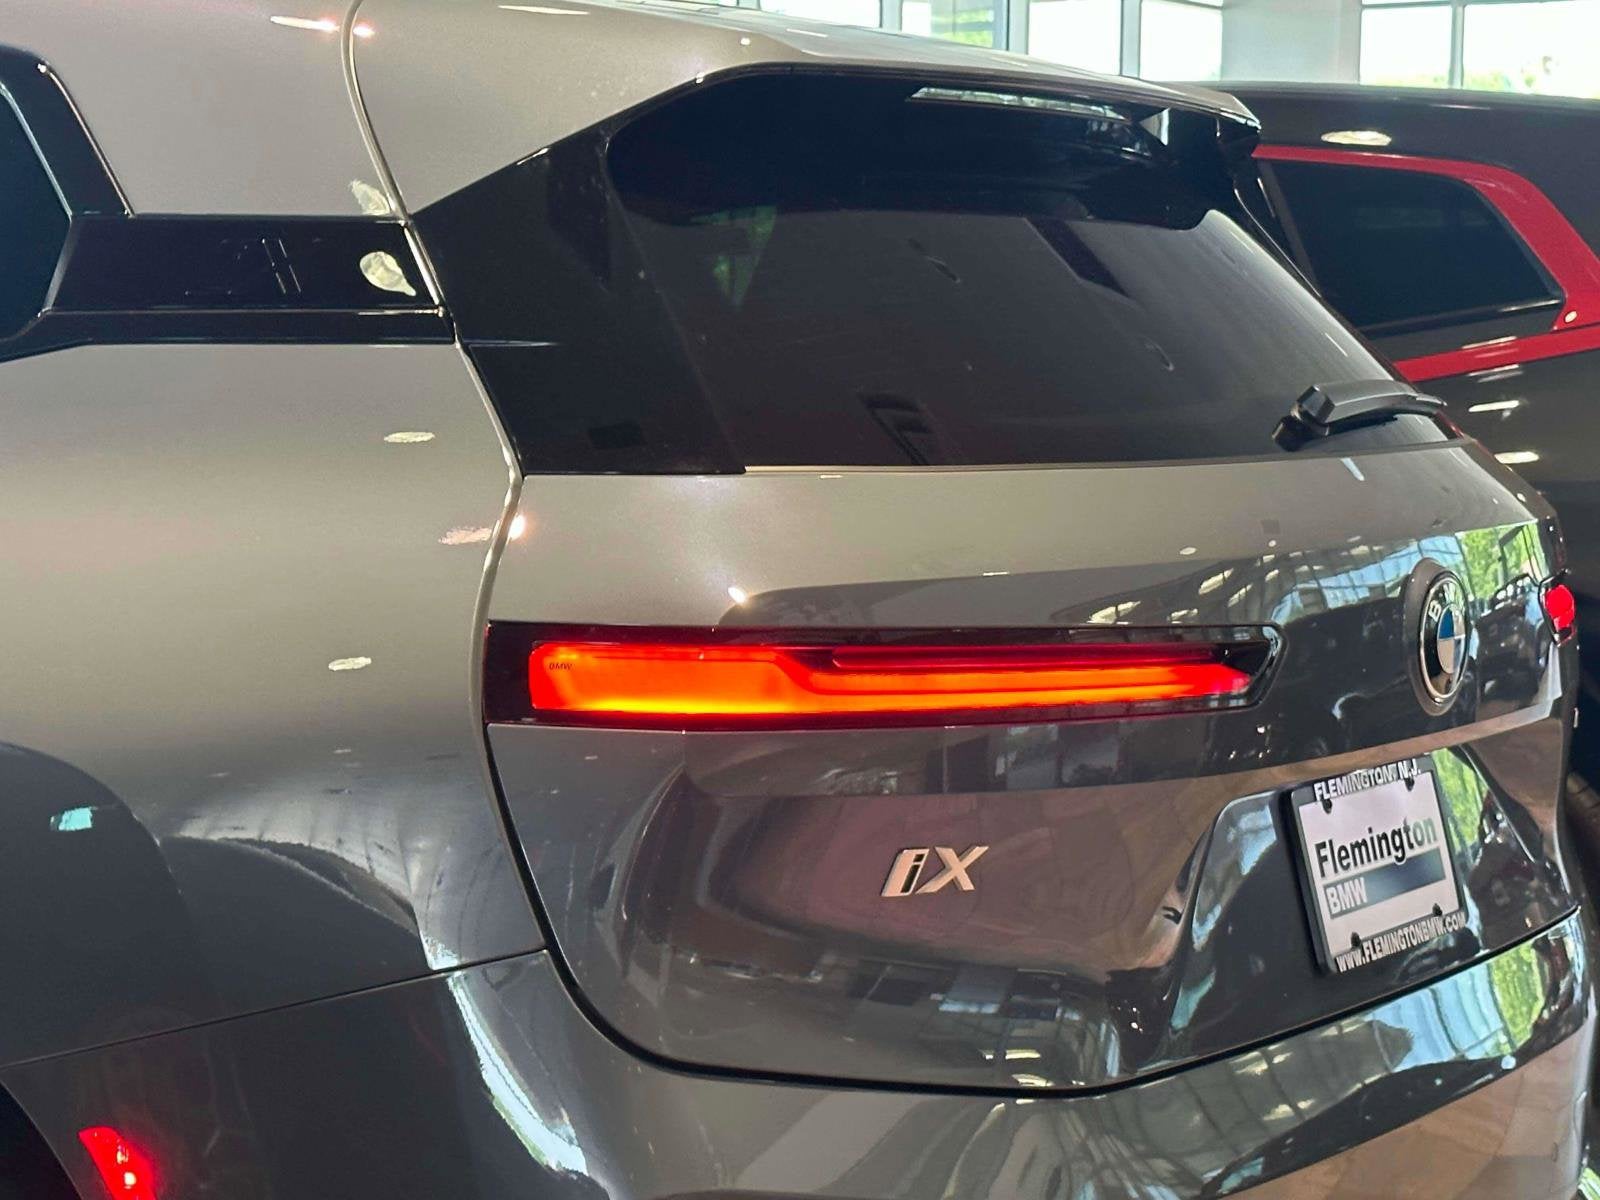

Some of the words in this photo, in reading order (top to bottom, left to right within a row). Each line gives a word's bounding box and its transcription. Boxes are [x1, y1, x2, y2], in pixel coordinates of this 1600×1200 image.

[881, 845, 989, 897] iX
[1315, 816, 1438, 878] Flemington
[1326, 877, 1367, 914] BMW
[1336, 911, 1466, 973] WWW.FLEMINGTONBMW.COM
